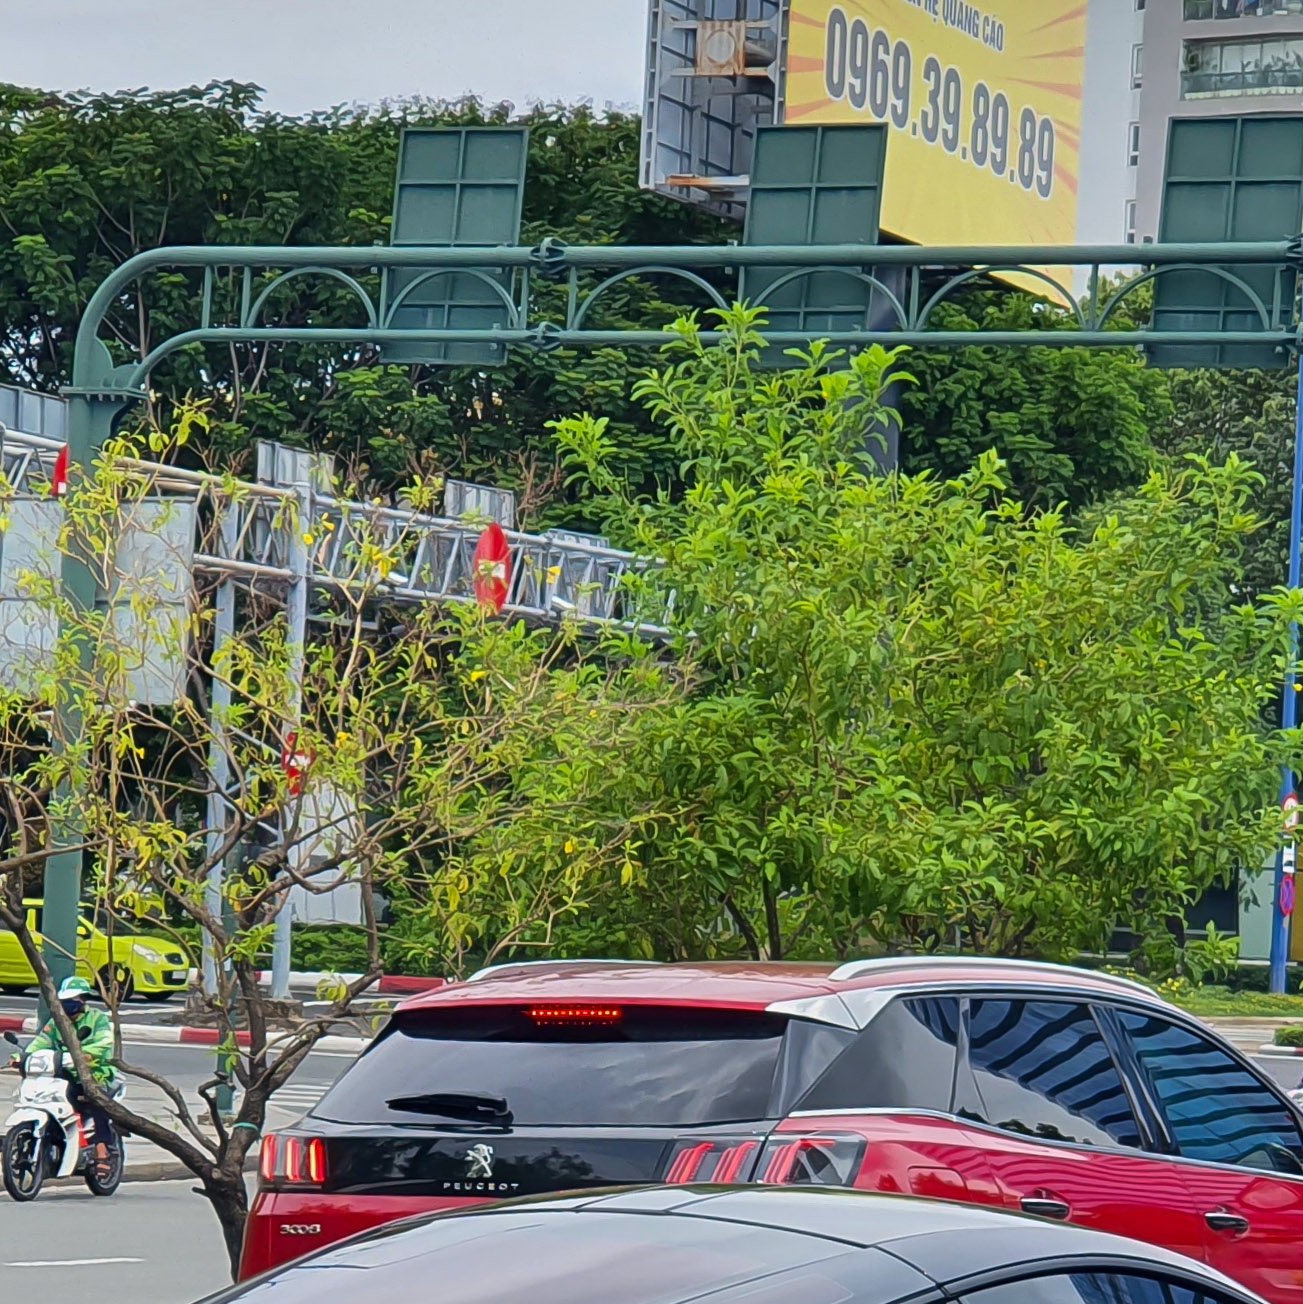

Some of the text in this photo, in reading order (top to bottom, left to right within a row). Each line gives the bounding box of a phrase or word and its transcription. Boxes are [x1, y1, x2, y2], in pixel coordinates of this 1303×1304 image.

[982, 14, 1004, 51] CÁO
[825, 8, 1054, 198] 0969.39.89.89
[443, 1182, 519, 1191] PEUGEOT
